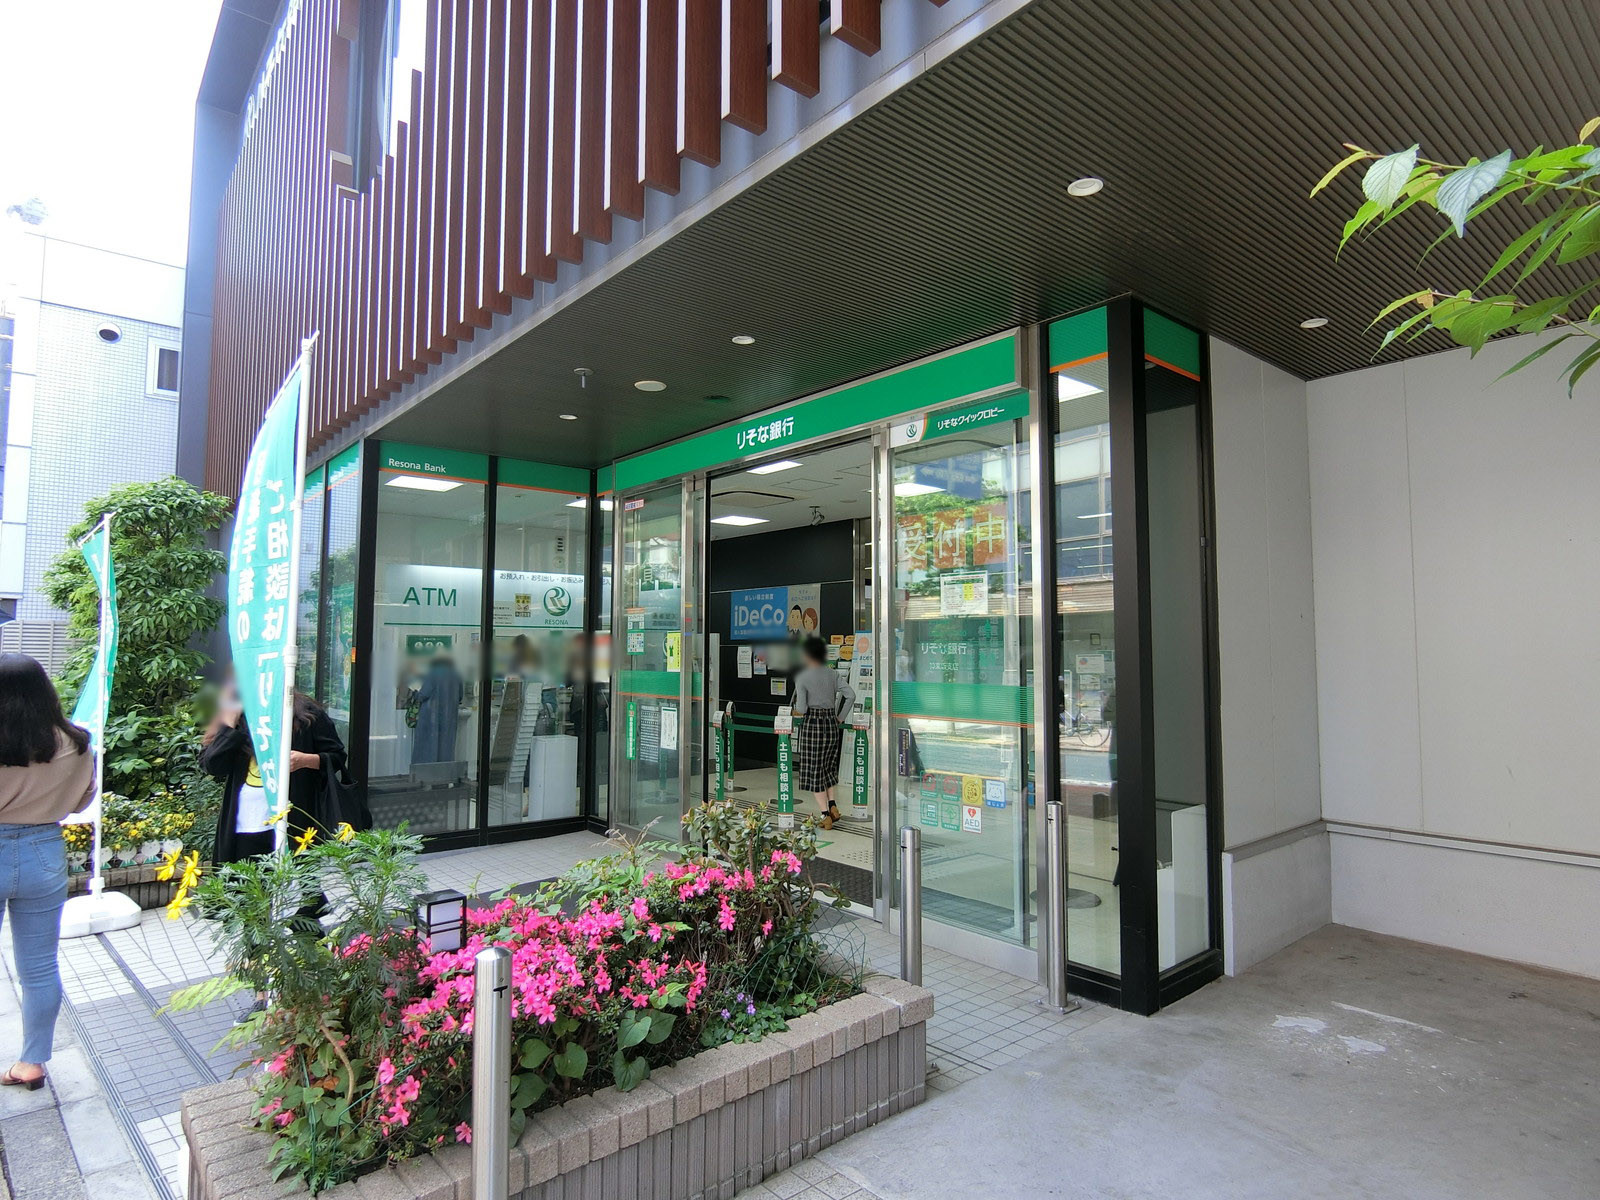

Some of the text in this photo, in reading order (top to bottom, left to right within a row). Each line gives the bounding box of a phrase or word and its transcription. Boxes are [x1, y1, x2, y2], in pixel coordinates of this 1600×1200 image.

[937, 406, 1004, 430] りそなクイックロビー
[736, 416, 795, 450] りそな銀行
[388, 457, 447, 473] Resona Bank
[897, 512, 1006, 562] 受付中
[402, 586, 457, 607] ATM
[544, 618, 569, 626] RESONA
[734, 603, 785, 628] iDeCo
[921, 642, 967, 655] りそな銀行
[964, 818, 980, 828] AED
